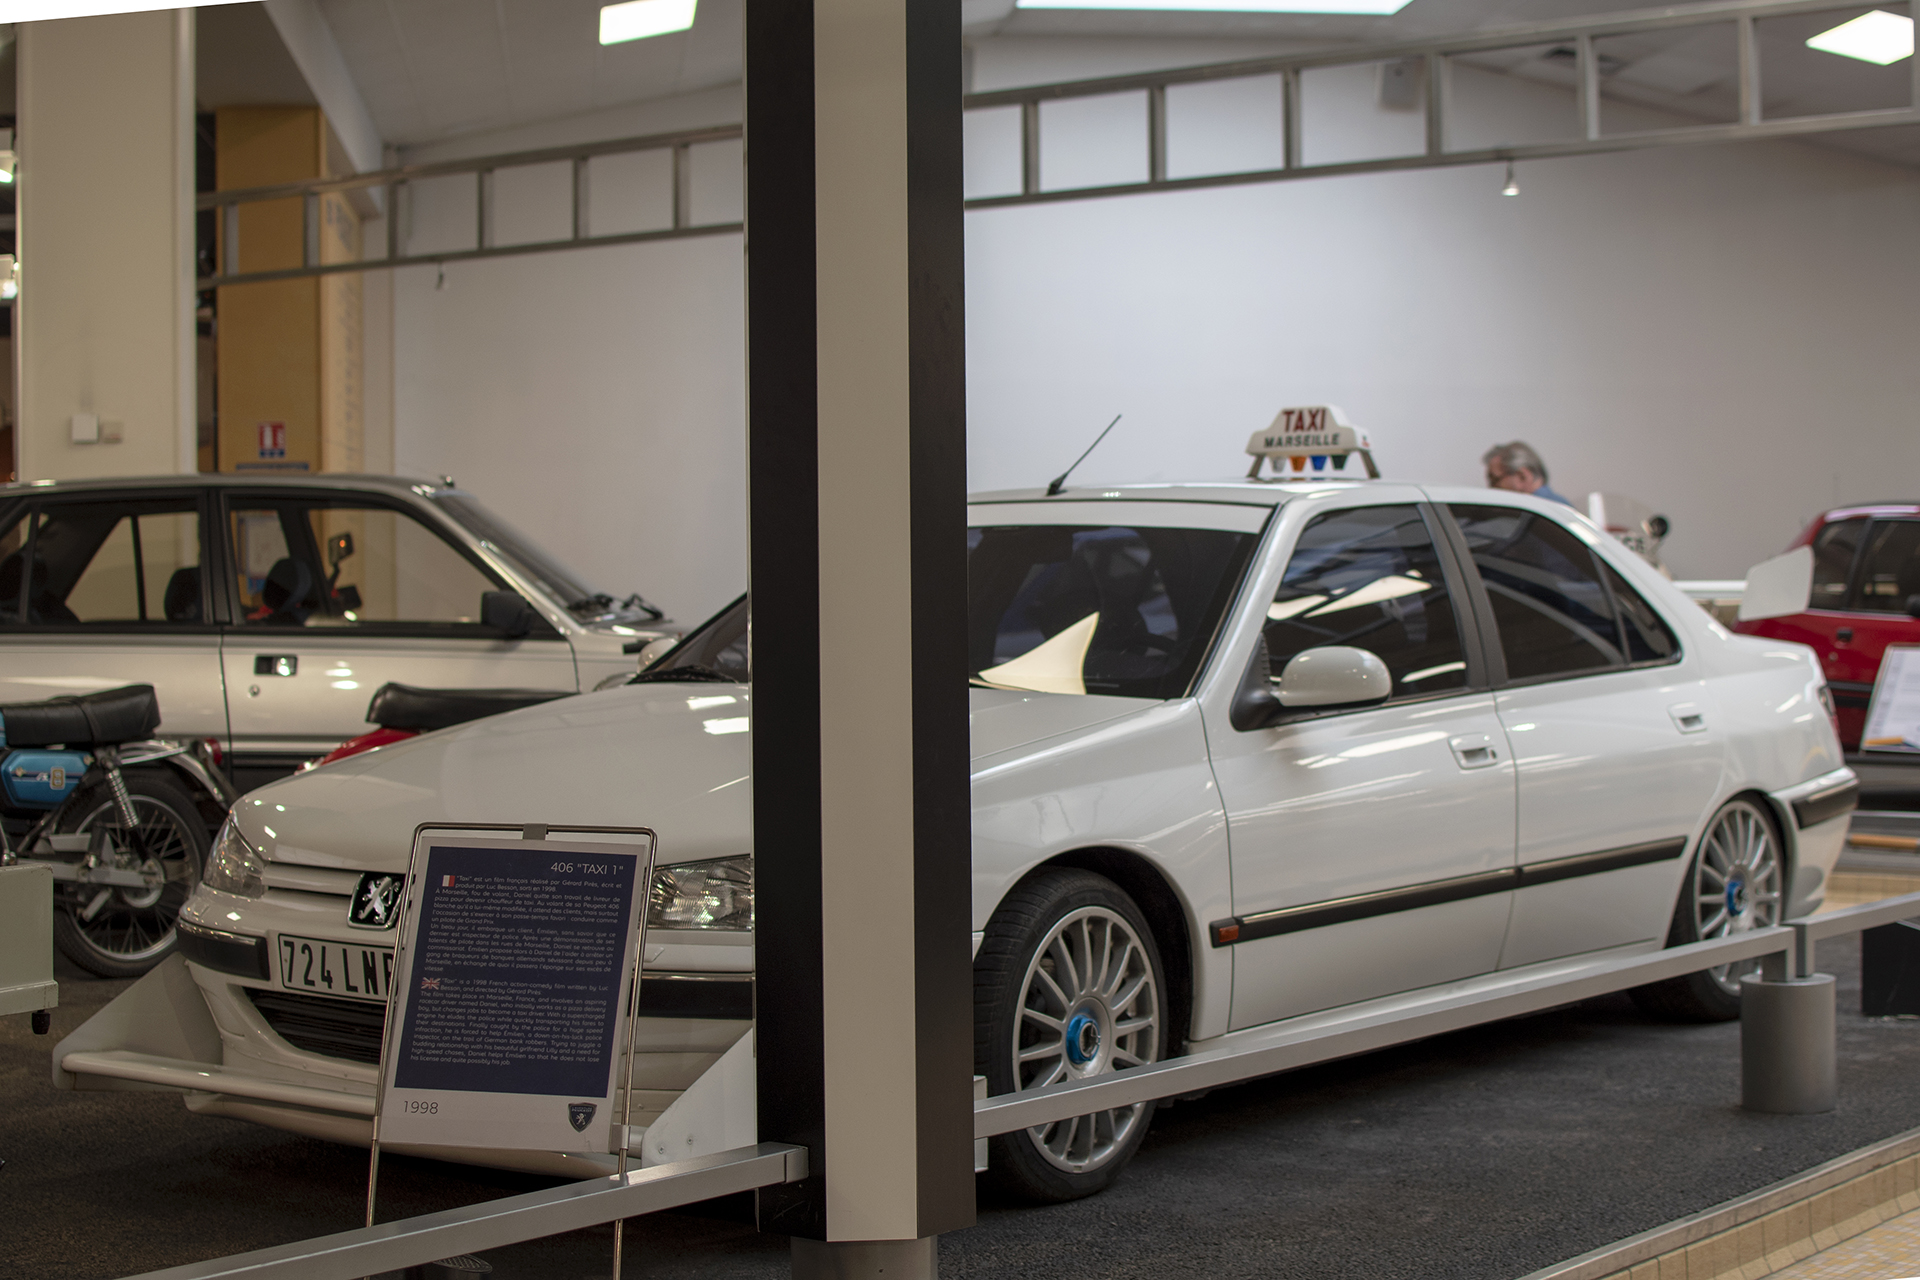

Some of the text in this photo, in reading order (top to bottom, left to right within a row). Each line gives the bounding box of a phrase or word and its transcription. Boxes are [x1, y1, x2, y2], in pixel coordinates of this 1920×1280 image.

[1282, 408, 1327, 432] TAXI
[1264, 433, 1340, 448] MARSEILLE
[550, 862, 623, 874] 406 "TAXI 1"
[283, 940, 333, 990] 724
[404, 1100, 439, 1115] 1998
